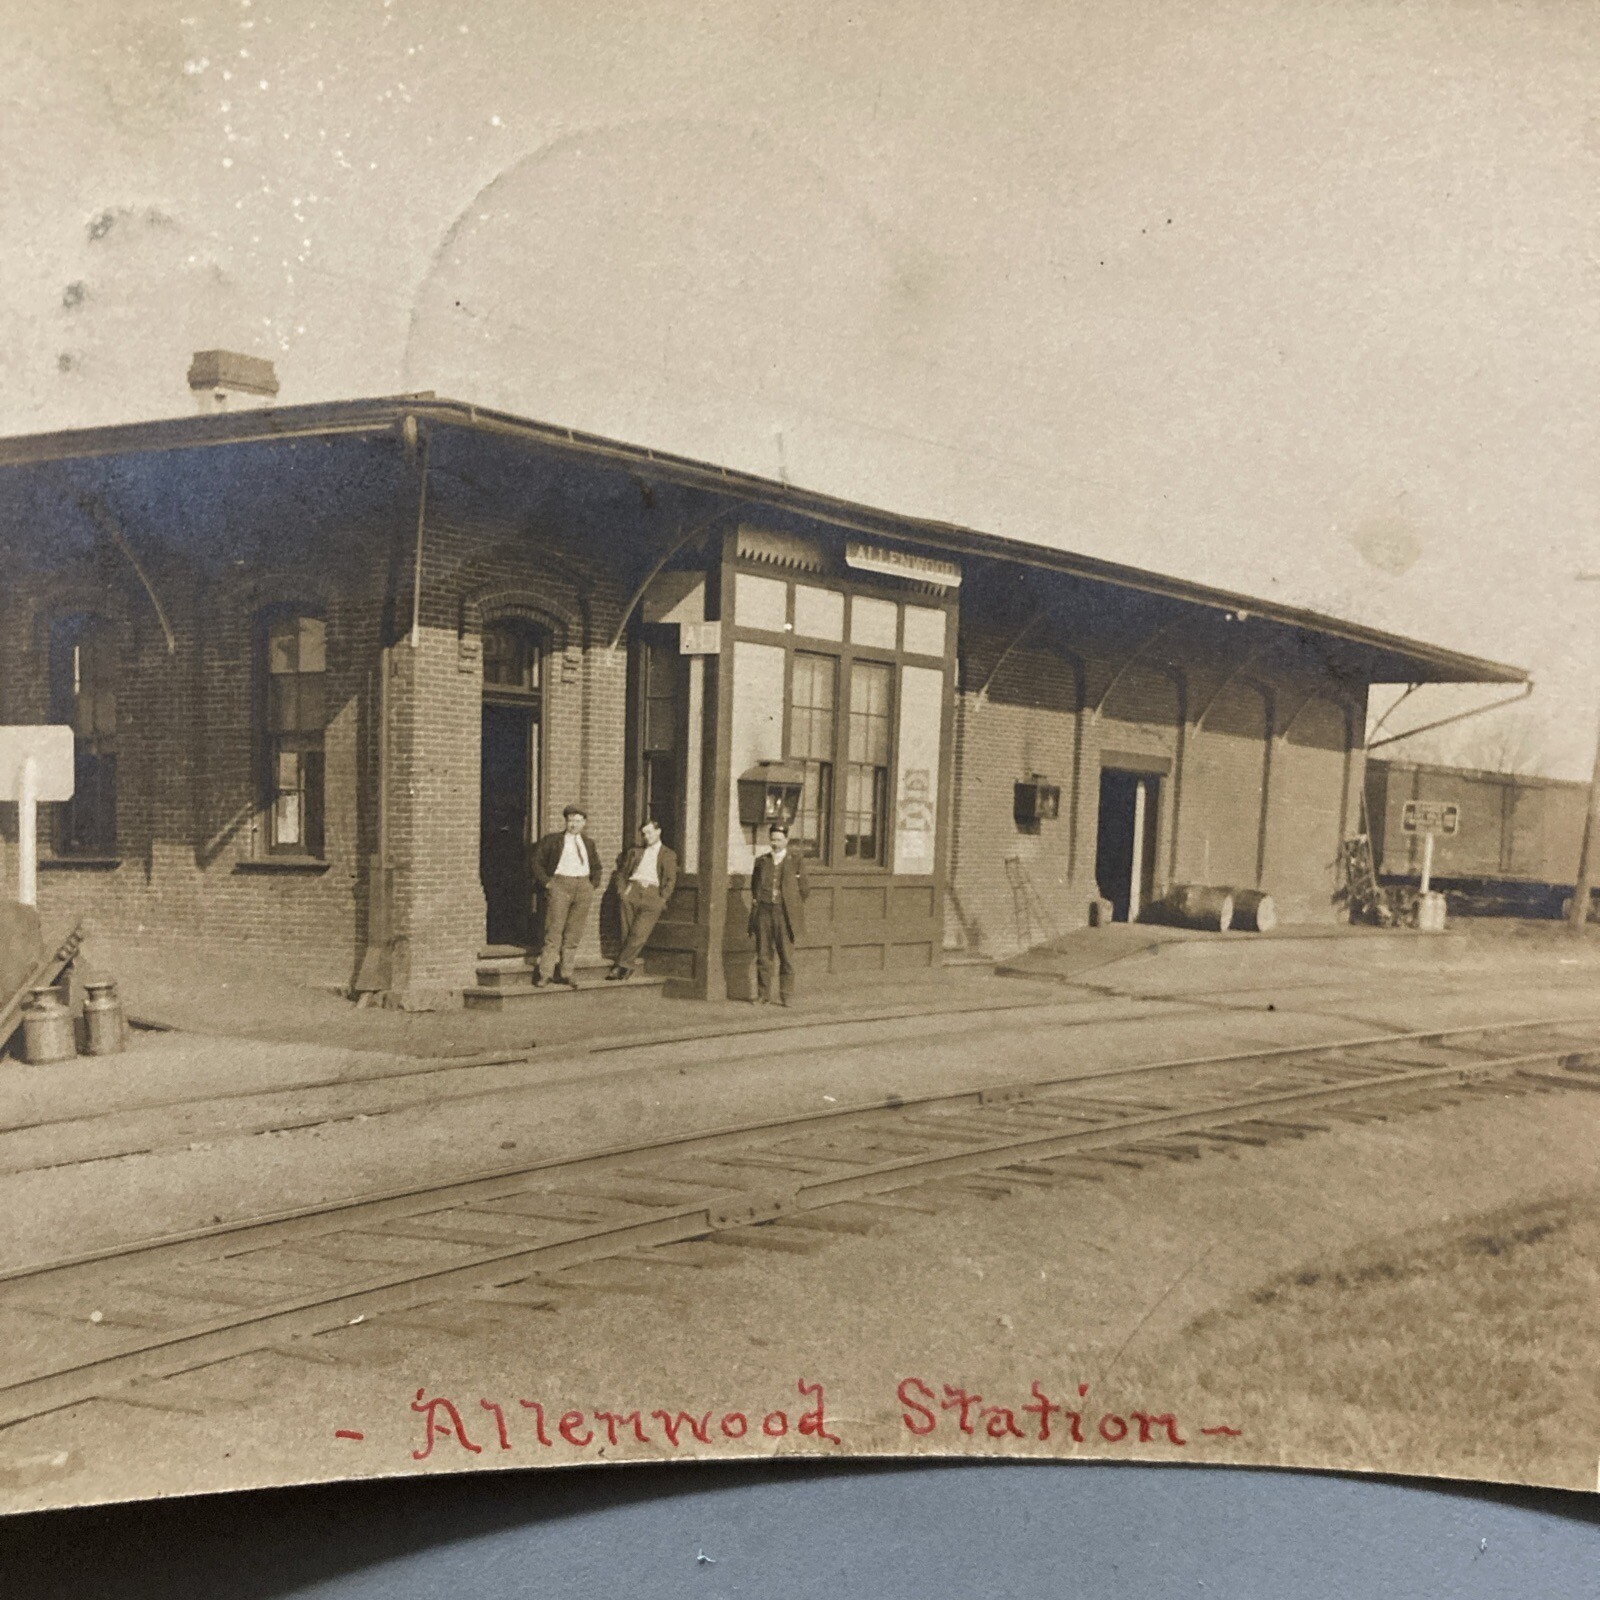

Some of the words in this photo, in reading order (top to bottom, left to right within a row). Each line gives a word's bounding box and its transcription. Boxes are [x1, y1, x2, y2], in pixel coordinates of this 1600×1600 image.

[856, 544, 956, 577] ALLENWOOD
[411, 1378, 842, 1460] Allenwood
[897, 1377, 1187, 1446] Station
